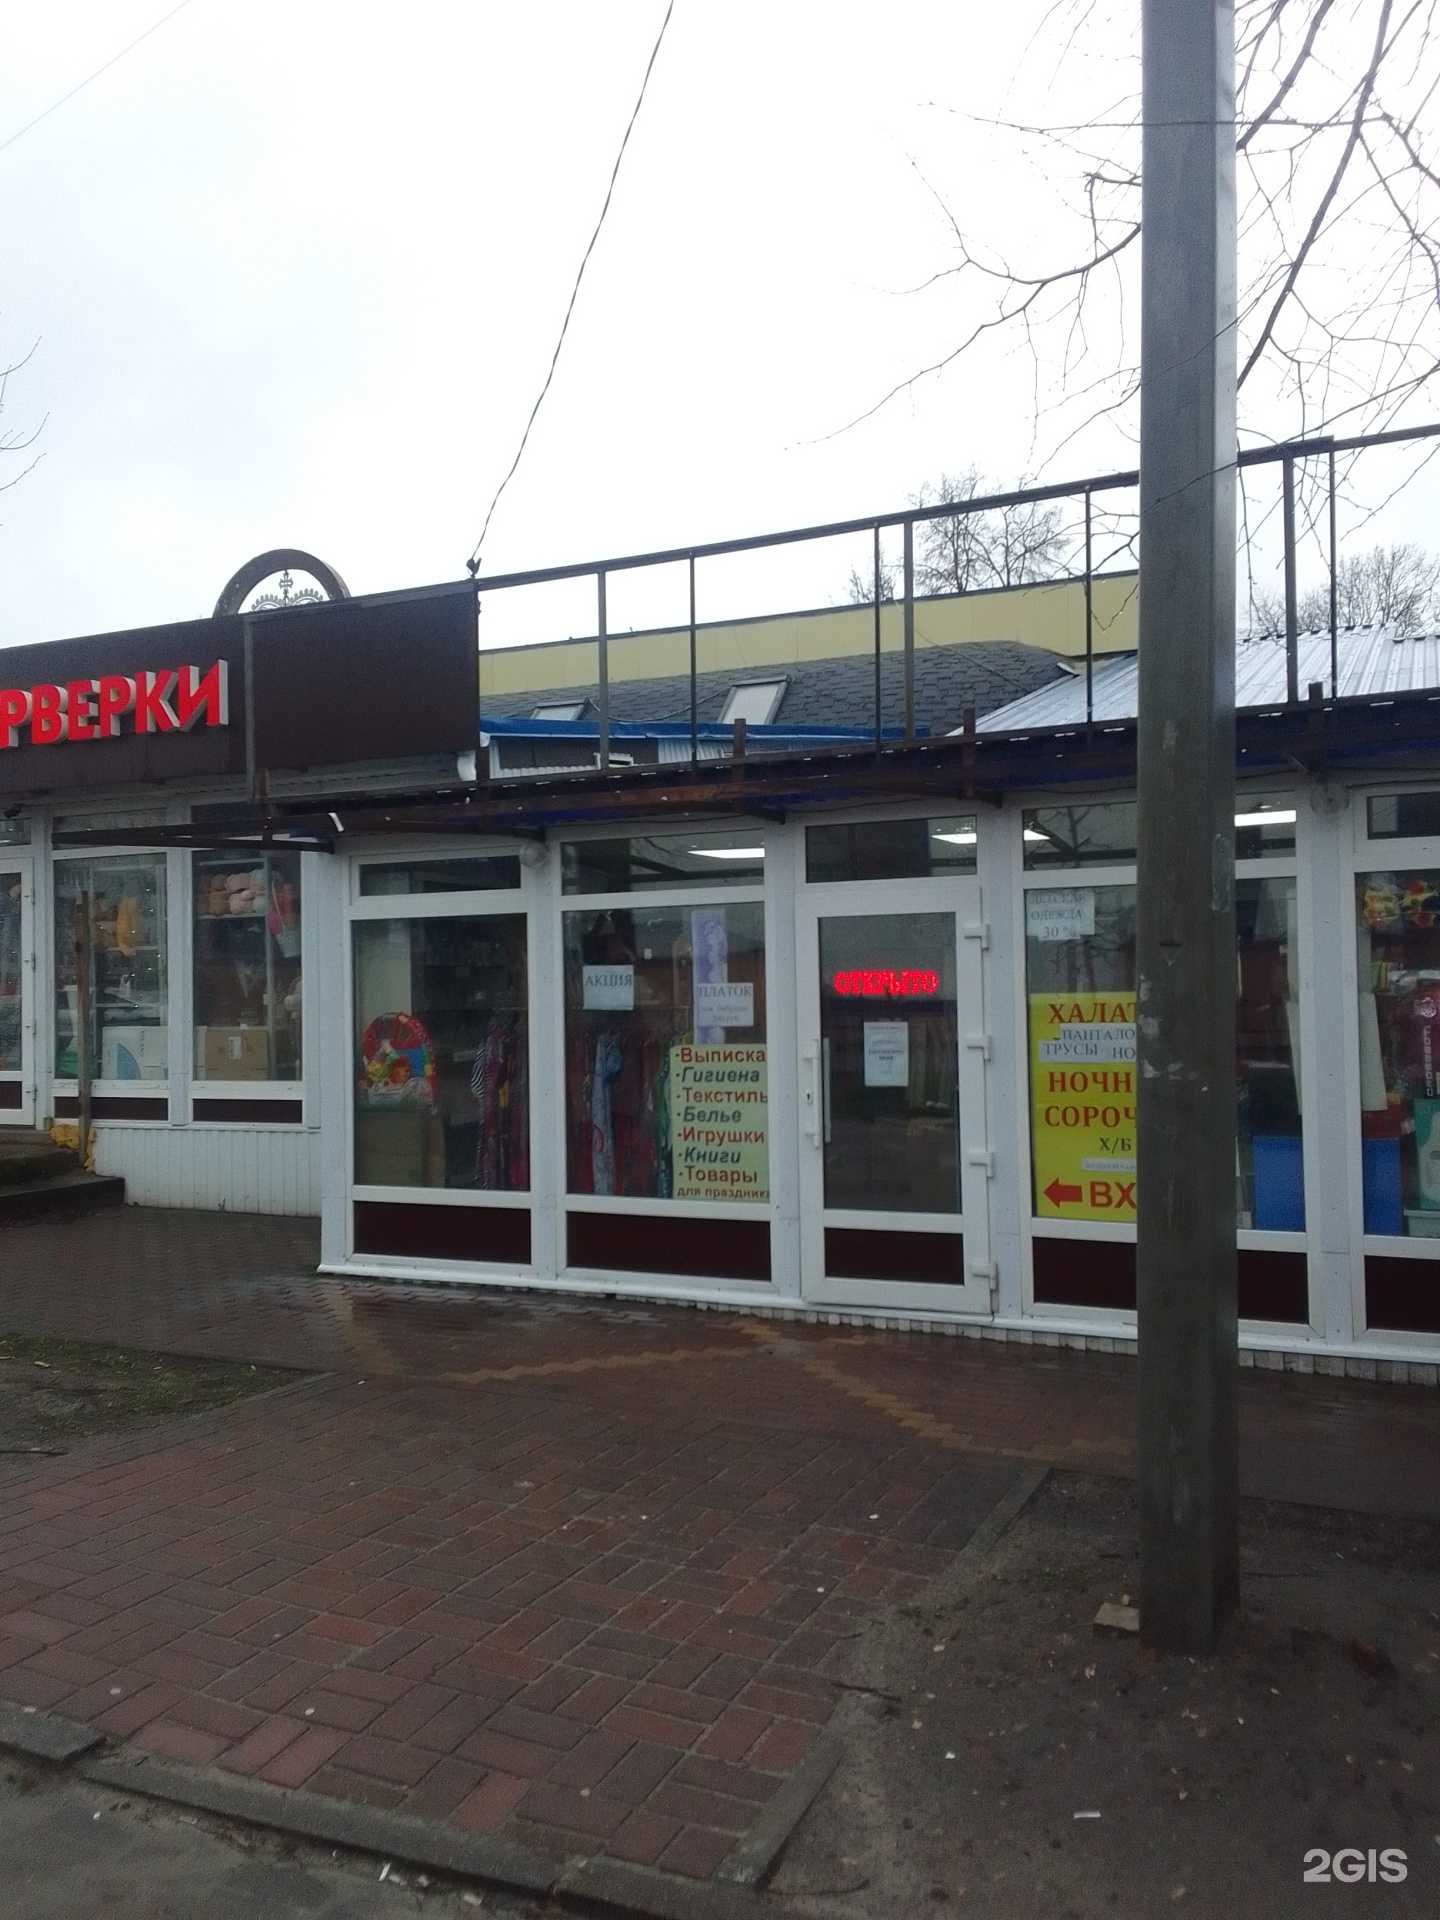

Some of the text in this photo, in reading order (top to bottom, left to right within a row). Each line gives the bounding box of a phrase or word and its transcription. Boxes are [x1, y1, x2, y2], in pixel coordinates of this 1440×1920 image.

[0, 659, 229, 749] РВЕРКИ
[585, 974, 633, 988] АКЦИЯ
[834, 970, 939, 997] ОТКРЫТО
[680, 1047, 766, 1063] Выписка
[1042, 1043, 1098, 1056] ТРУСЫ
[681, 1066, 760, 1082] Гигиена
[1048, 1071, 1133, 1093] НОЧН
[682, 1087, 768, 1103] Текстиль
[683, 1106, 742, 1122] Белье
[683, 1126, 764, 1146] Игрушки
[684, 1146, 741, 1163] Книги
[684, 1165, 758, 1187] Товары
[705, 1188, 769, 1199] праздник
[1090, 1182, 1136, 1209] ВХ
